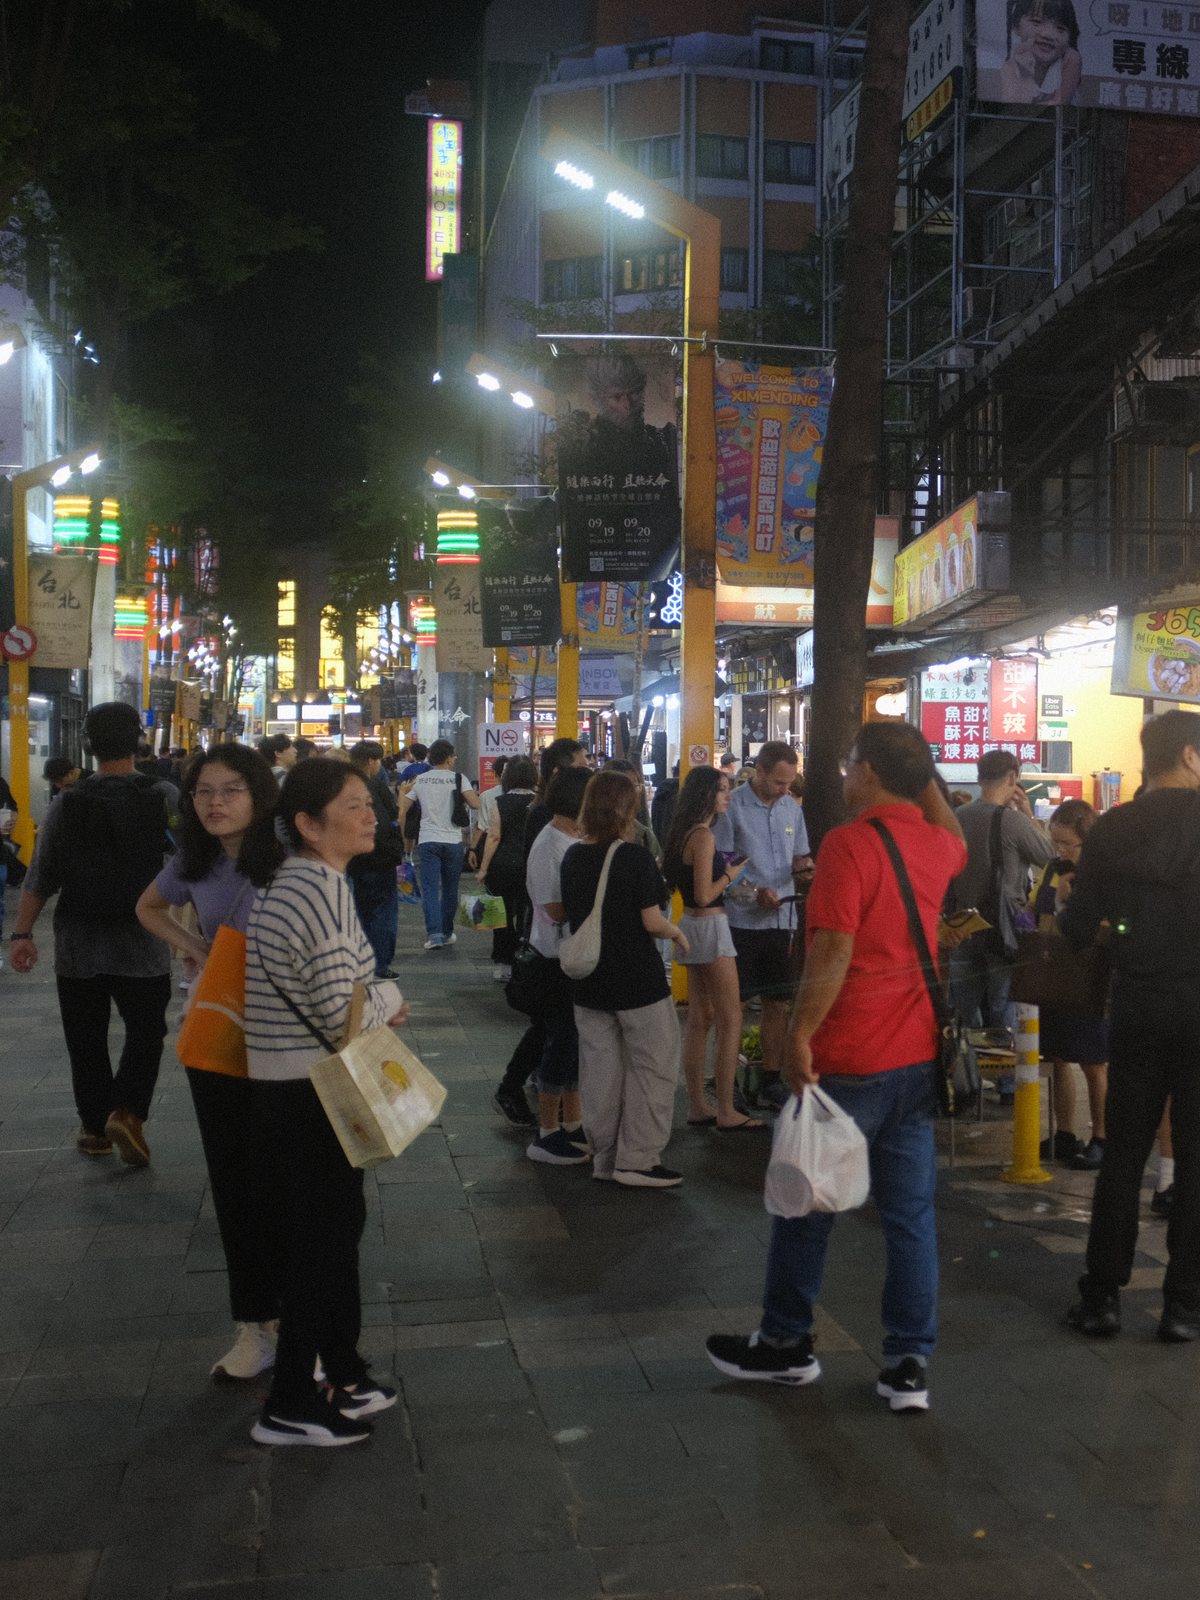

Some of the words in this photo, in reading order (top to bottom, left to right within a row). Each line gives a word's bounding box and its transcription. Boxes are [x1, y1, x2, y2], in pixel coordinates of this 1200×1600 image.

[433, 186, 446, 258] HOTEL
[732, 373, 797, 385] WELCOME
[802, 378, 819, 389] TO
[731, 390, 820, 407] XIMENDING
[604, 527, 614, 537] 19
[638, 527, 651, 536] 20
[1002, 661, 1027, 734] 甜不辣
